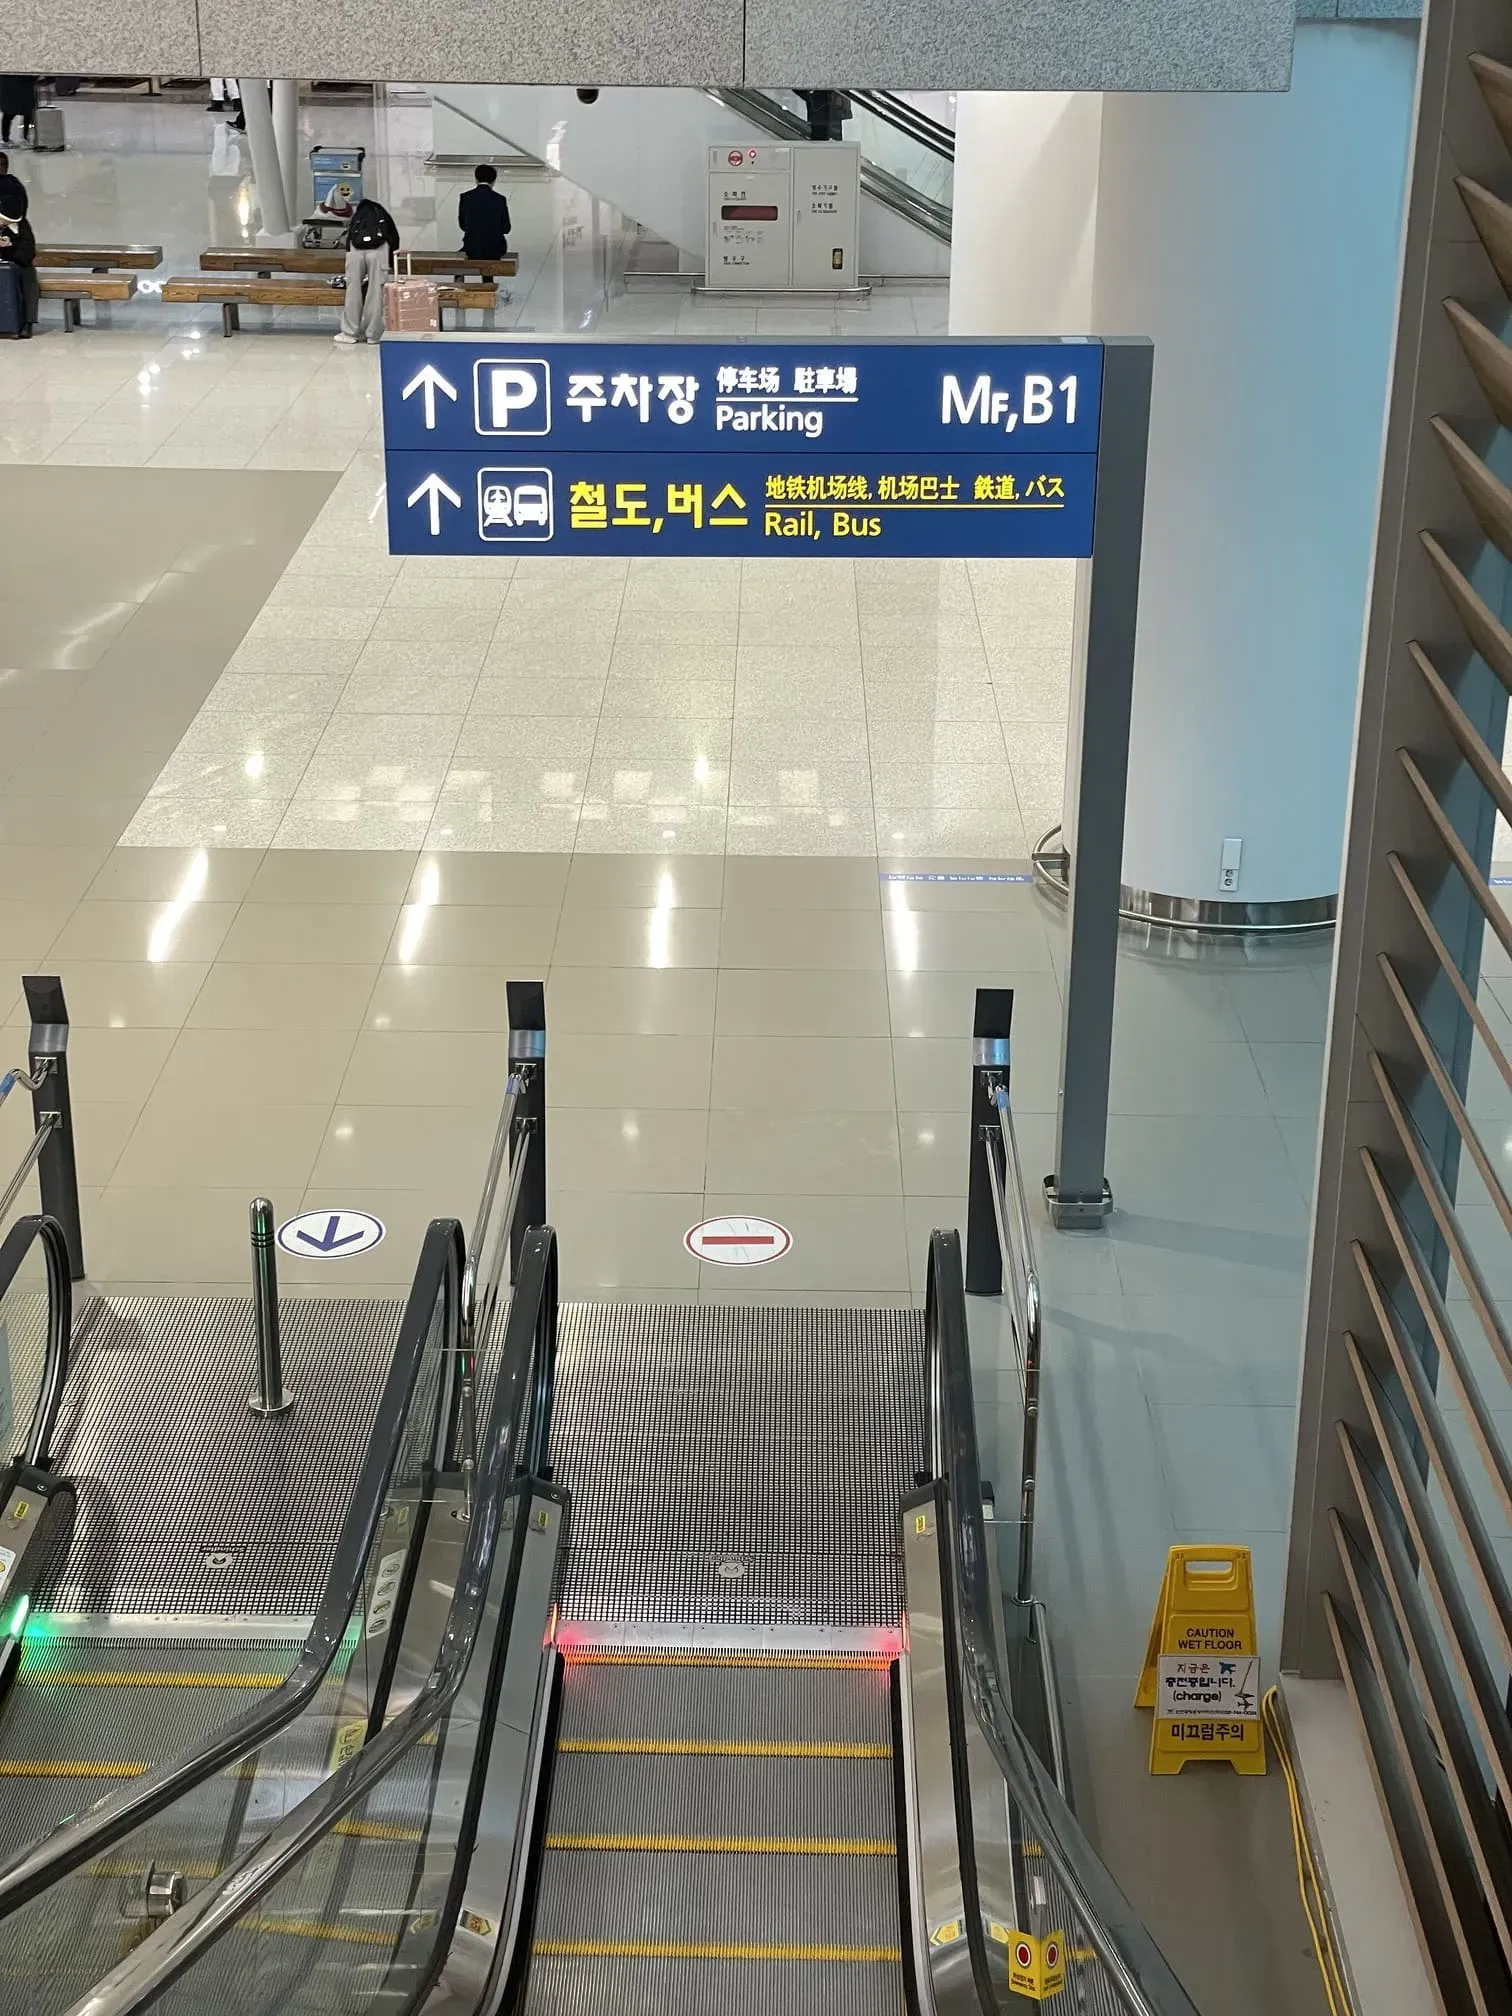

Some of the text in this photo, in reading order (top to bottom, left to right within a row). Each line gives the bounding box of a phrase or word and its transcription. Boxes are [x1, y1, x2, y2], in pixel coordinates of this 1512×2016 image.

[716, 366, 858, 395] 停车场 駐車場
[491, 368, 537, 428] P
[566, 373, 700, 425] 주차장
[716, 404, 823, 438] Parking
[569, 481, 749, 534] 철도,버스
[765, 510, 882, 541] Rail, Bus
[1178, 1640, 1242, 1650] WET FLOOR
[1186, 1628, 1234, 1638] CAUTION
[1173, 1690, 1222, 1703] (charge)
[1172, 1723, 1244, 1741] 미끄럼주의
